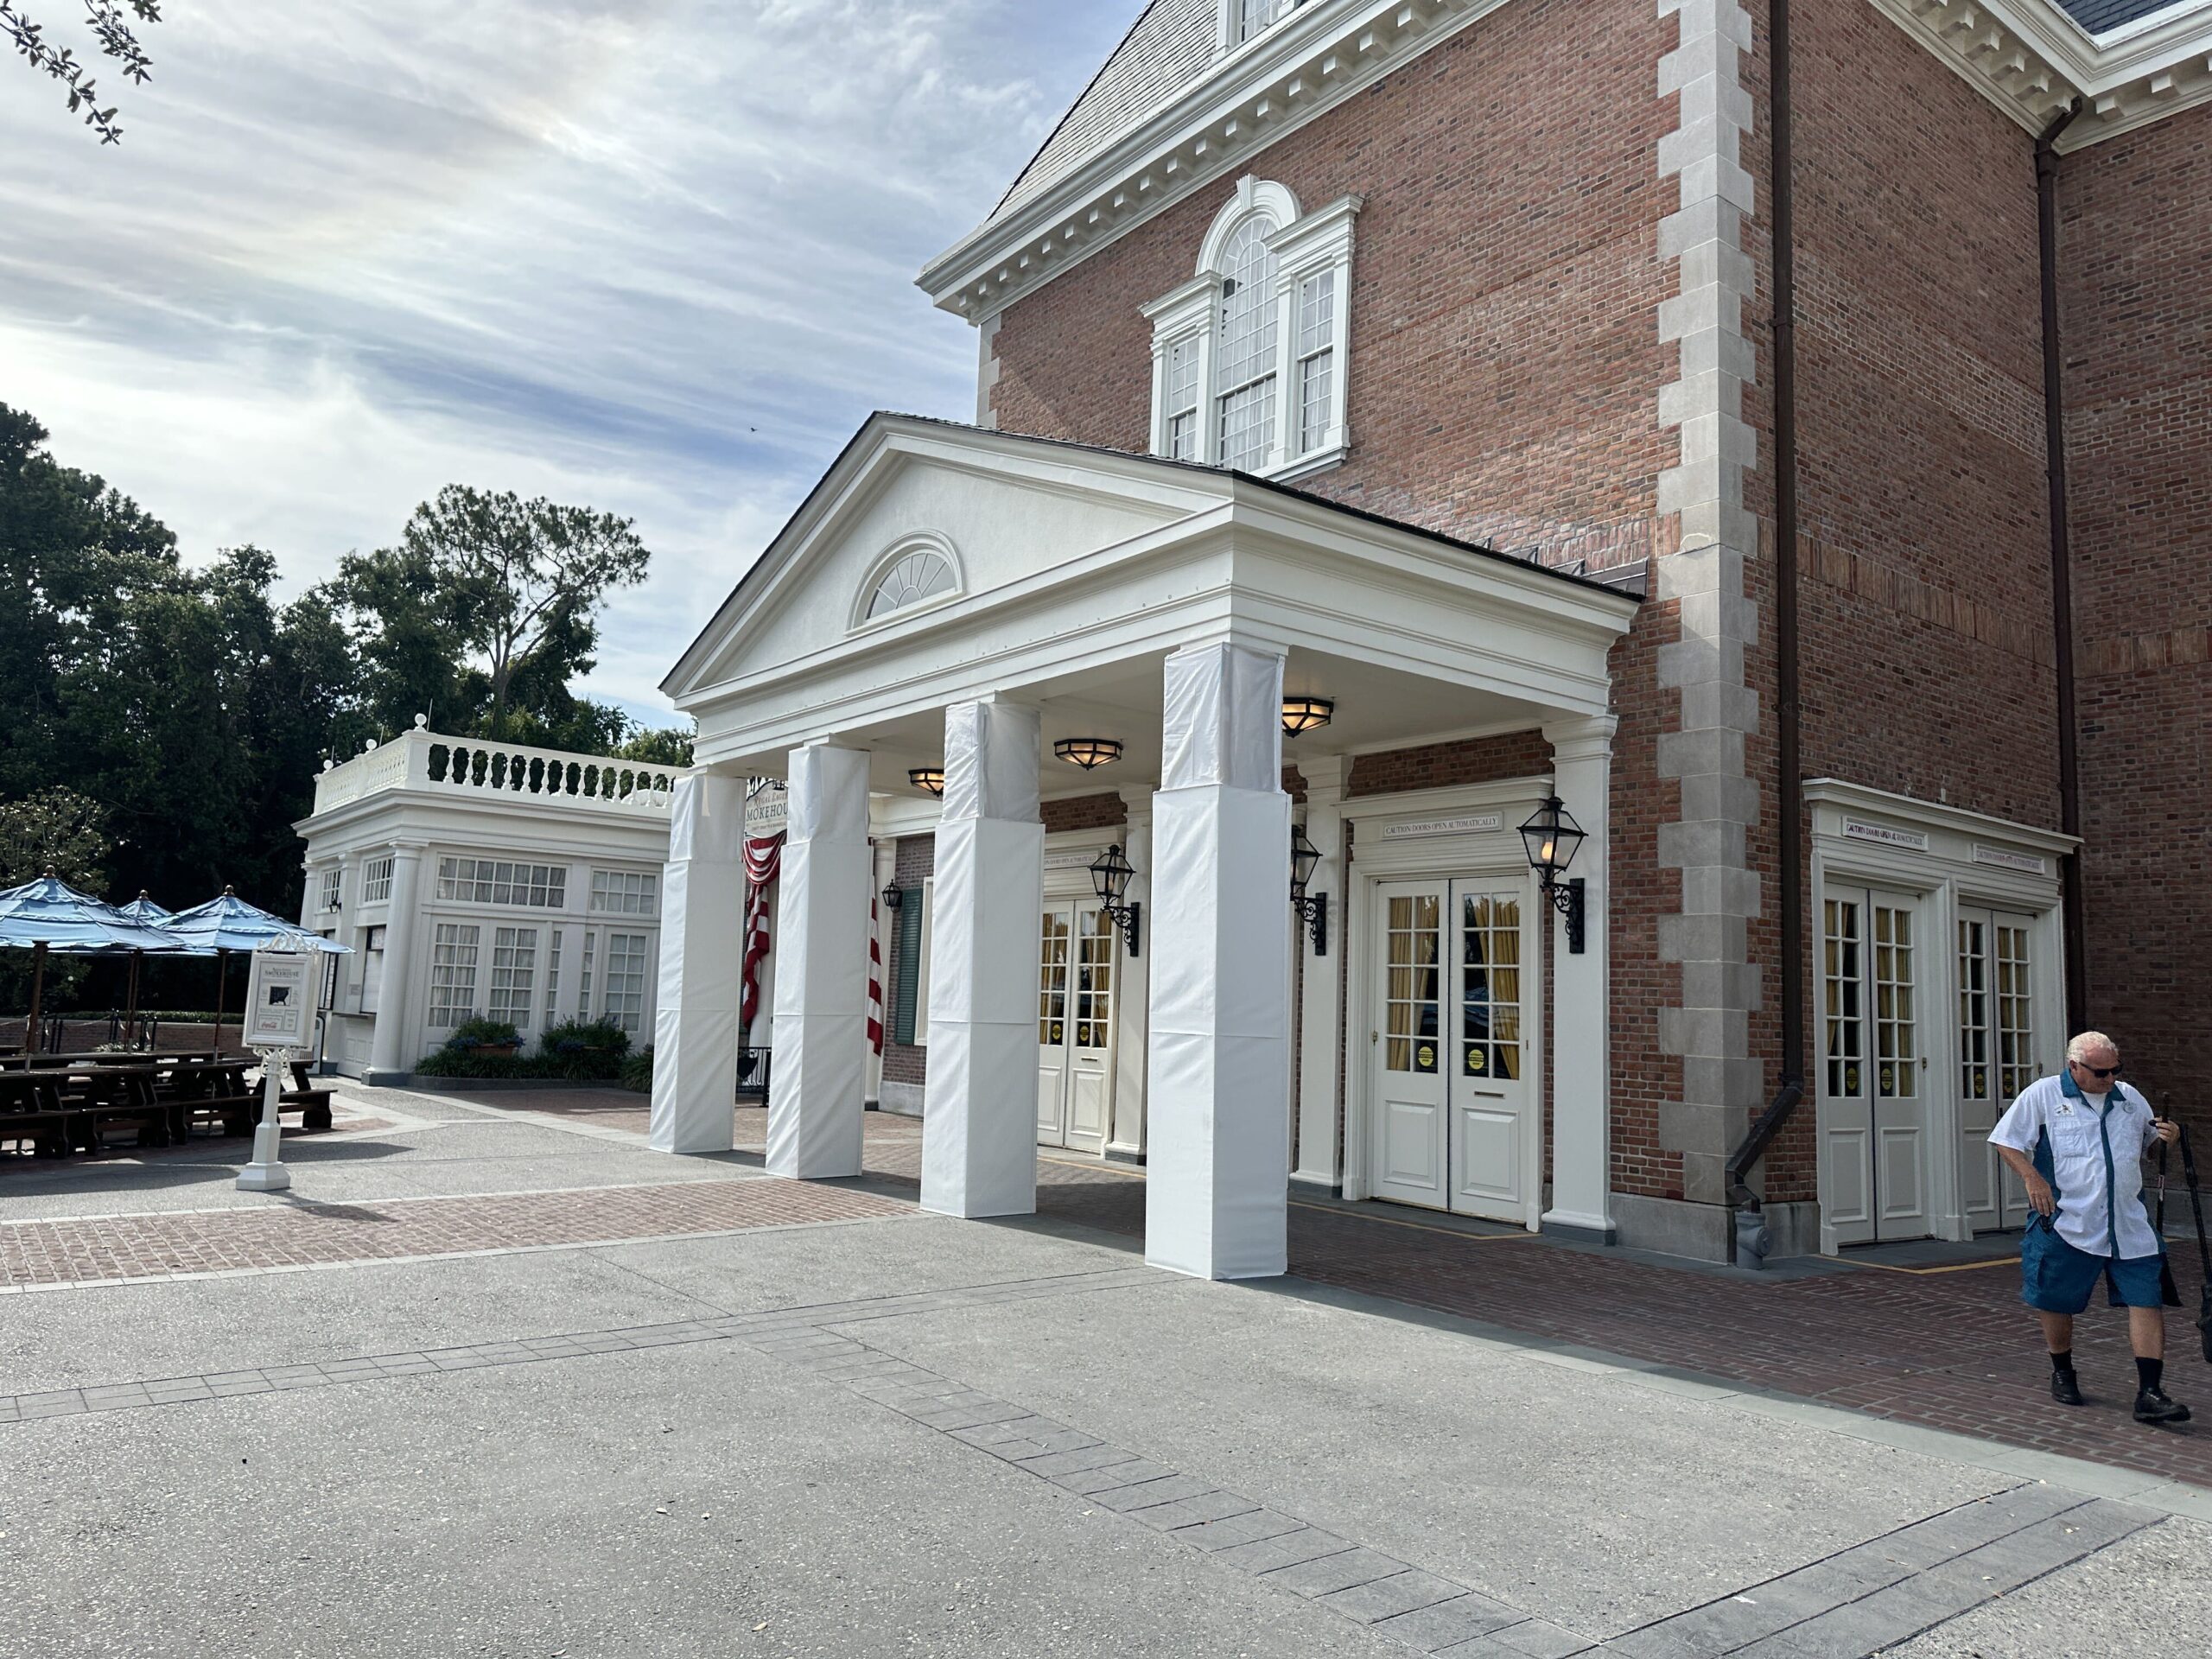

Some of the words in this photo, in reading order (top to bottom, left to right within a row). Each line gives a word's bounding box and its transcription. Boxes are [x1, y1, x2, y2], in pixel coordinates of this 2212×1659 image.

[747, 803, 788, 822] MOKEHOU
[1386, 824, 1411, 835] CAUTION
[1412, 823, 1432, 832] DOORS
[1432, 821, 1448, 831] OPEN
[1448, 817, 1497, 830] AUTOMATICALLY
